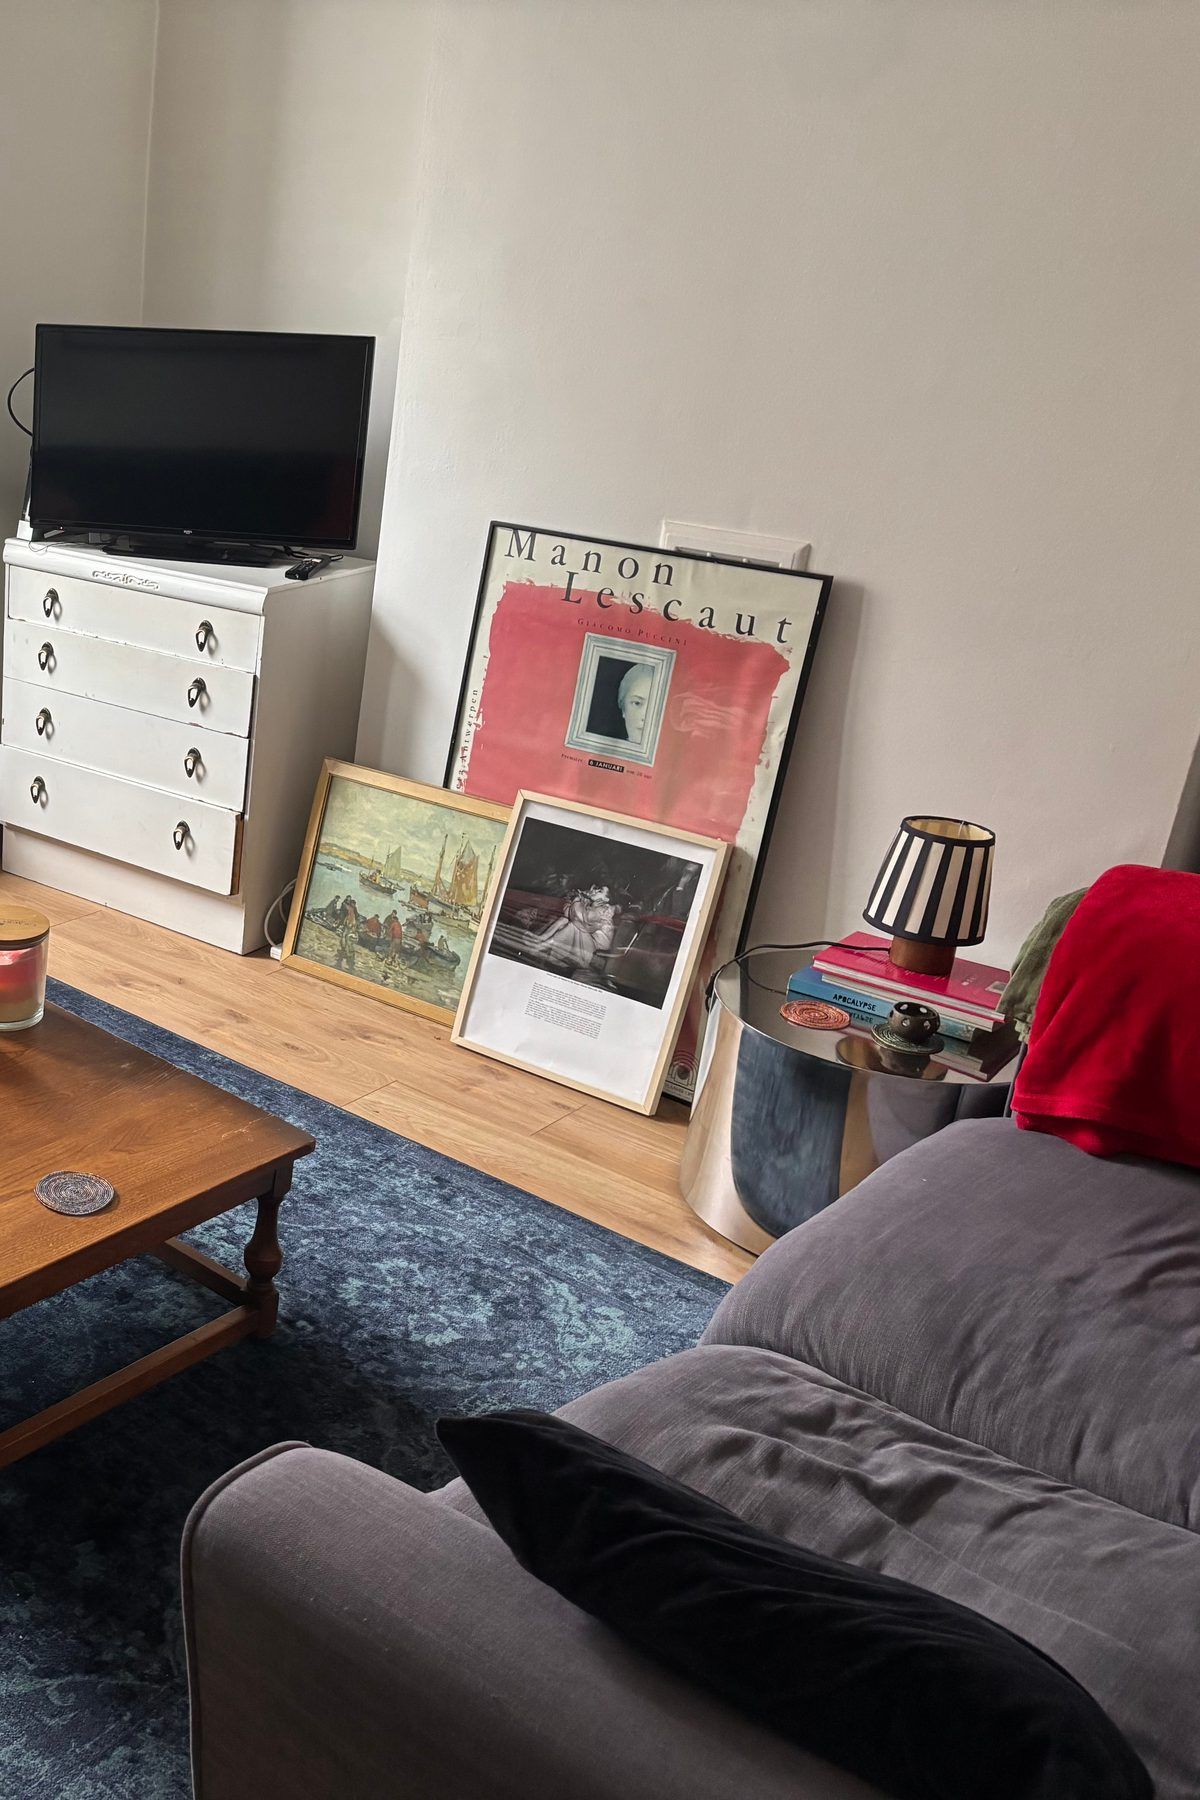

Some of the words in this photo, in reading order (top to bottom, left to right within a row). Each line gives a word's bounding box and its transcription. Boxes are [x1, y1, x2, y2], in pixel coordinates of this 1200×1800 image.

[504, 529, 674, 586] Manon
[561, 571, 792, 644] Lescaut
[460, 689, 478, 762] Antwerpen
[595, 761, 623, 772] JANUARI
[833, 993, 876, 1011] APOCALYPSE
